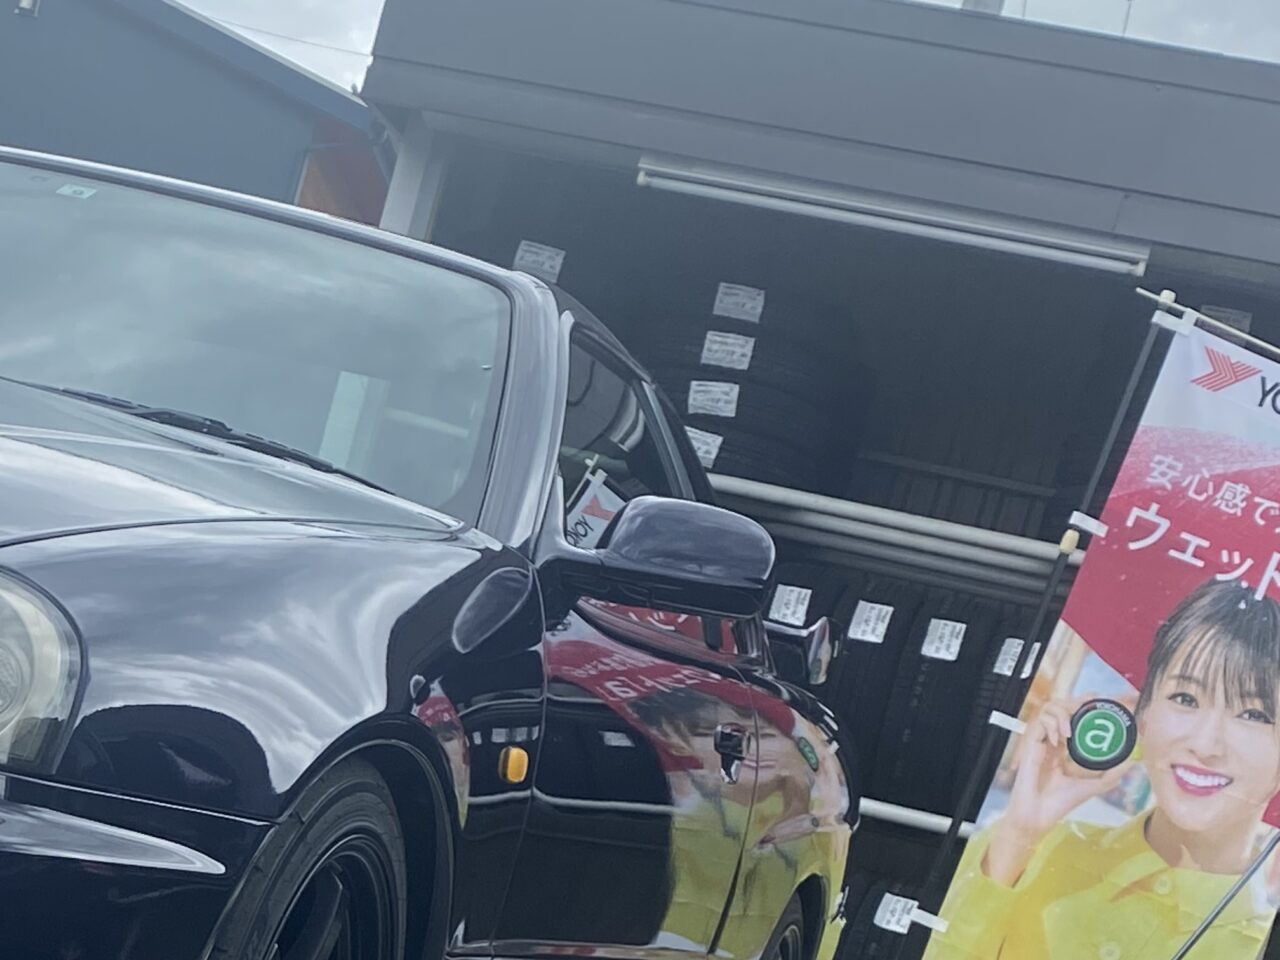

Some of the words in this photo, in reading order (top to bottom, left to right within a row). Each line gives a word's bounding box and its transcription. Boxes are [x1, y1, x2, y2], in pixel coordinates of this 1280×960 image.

[1145, 454, 1280, 535] 安心感で
[1085, 718, 1115, 751] a
